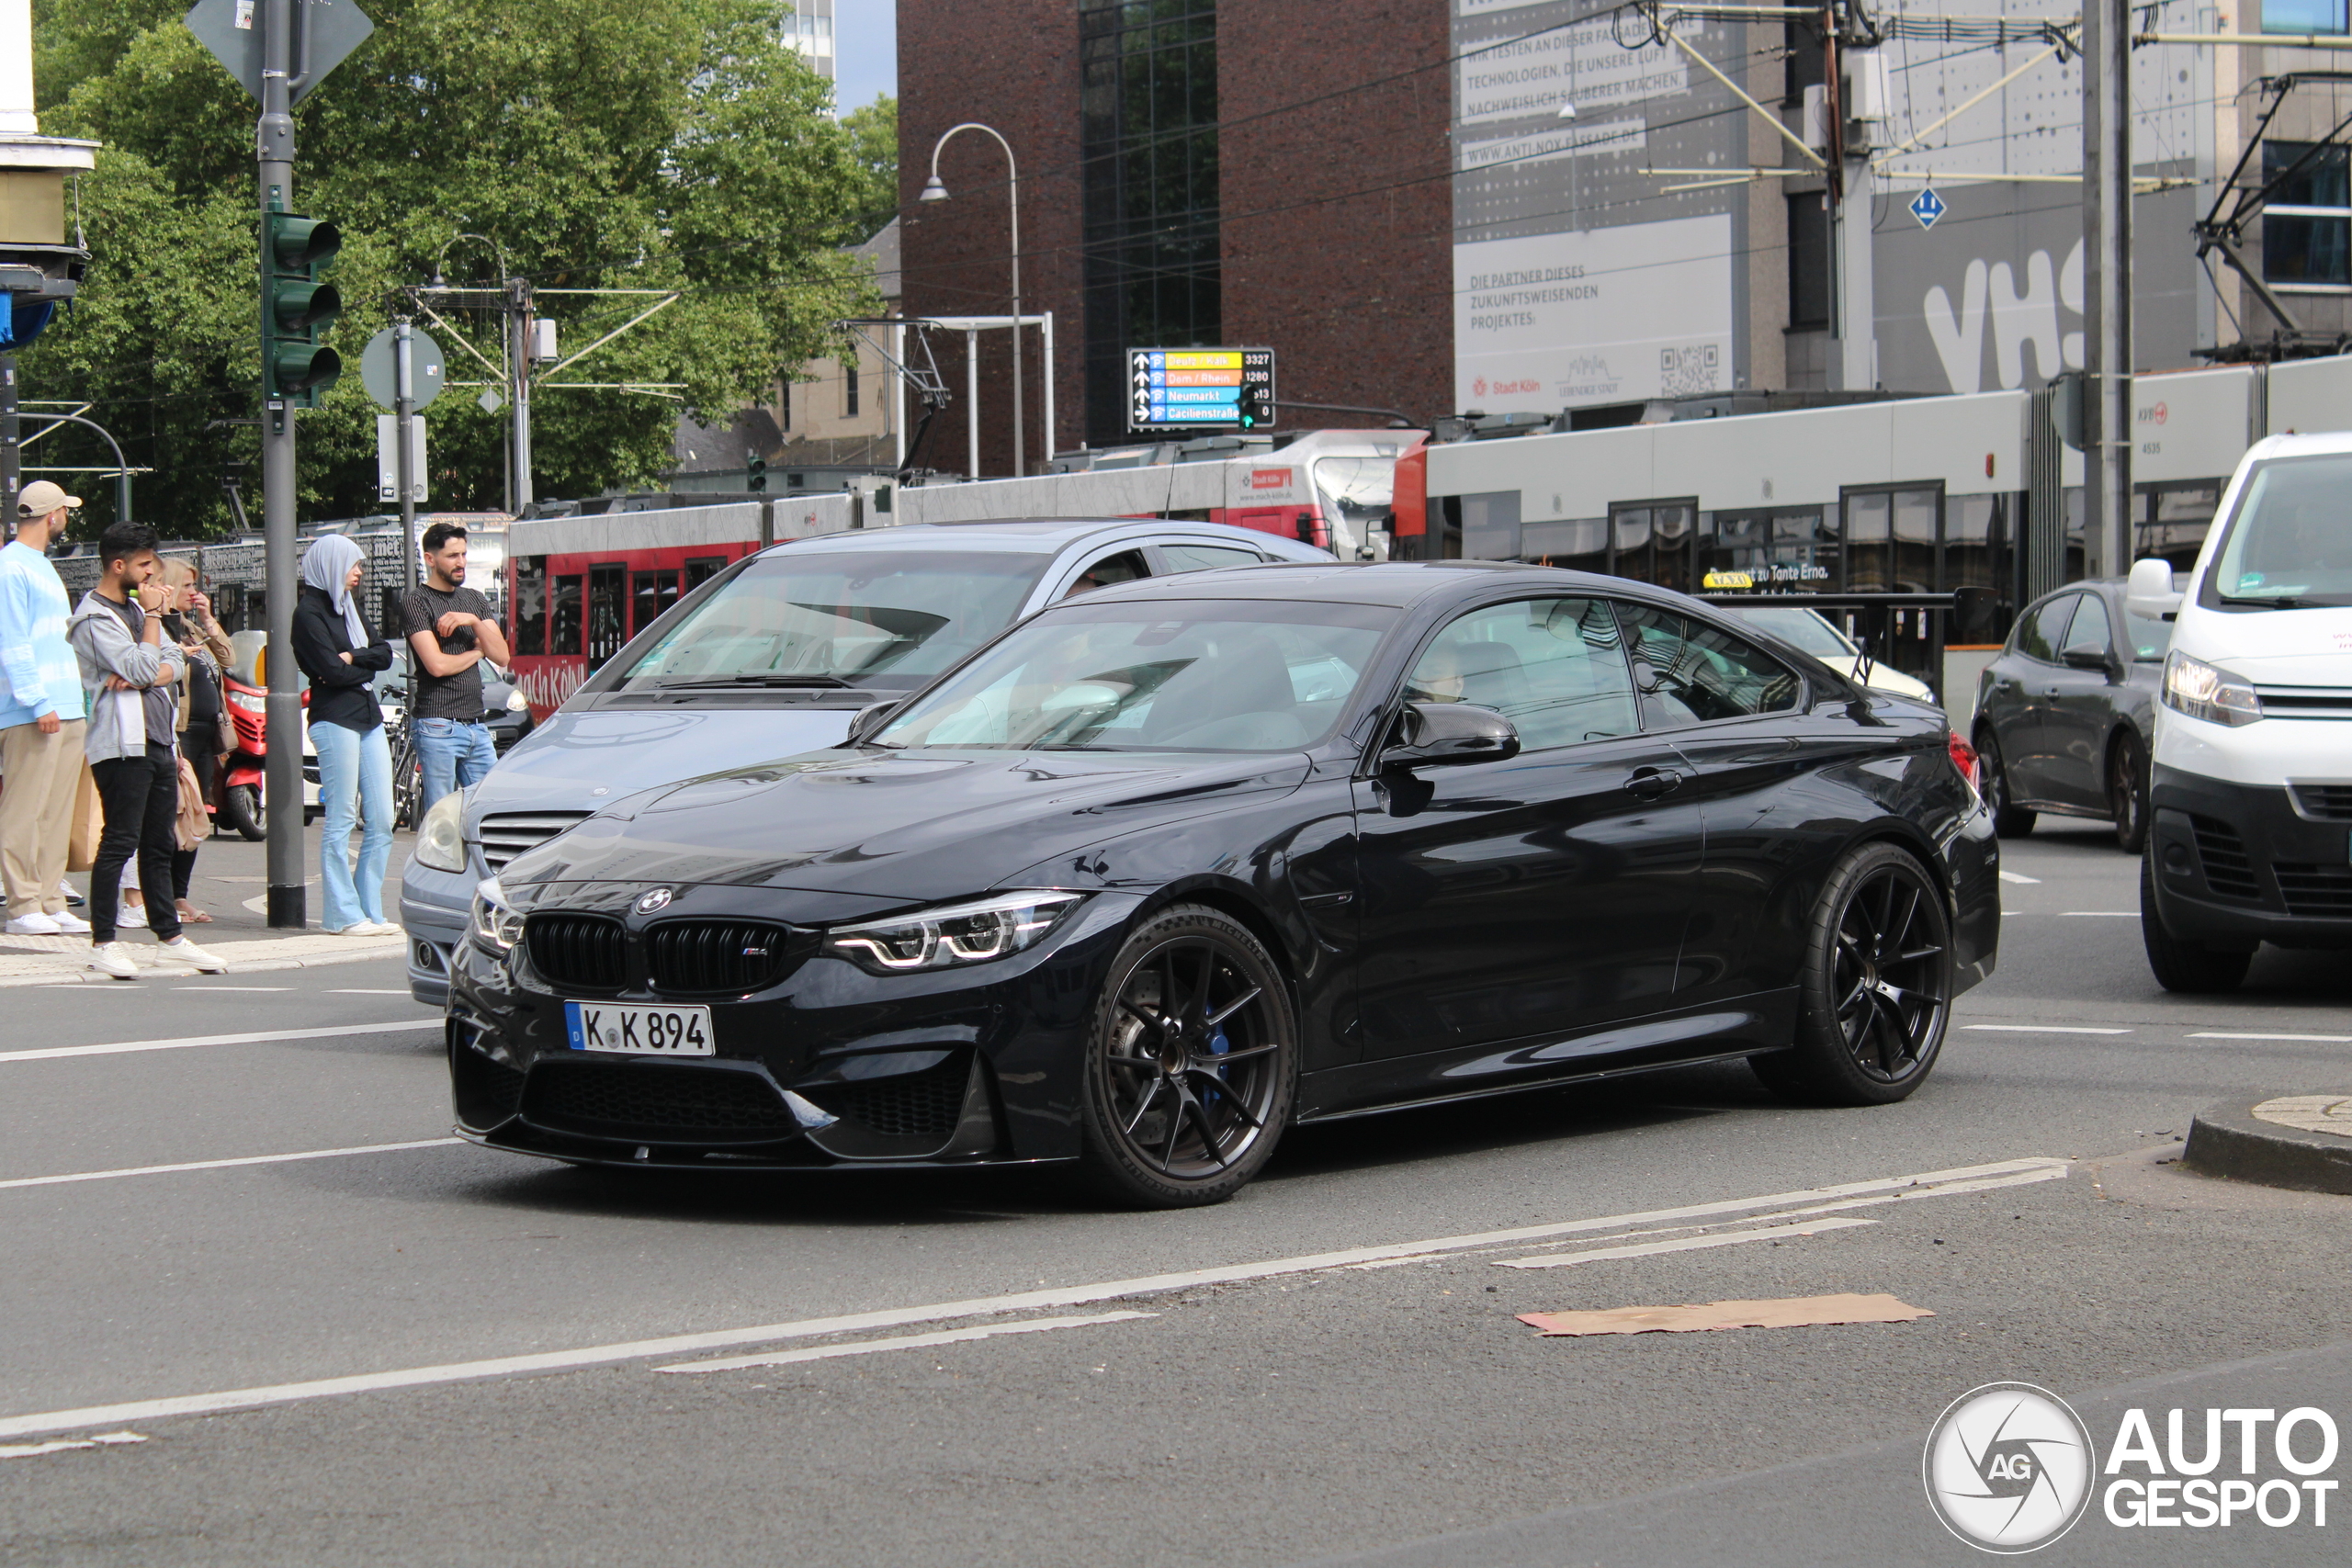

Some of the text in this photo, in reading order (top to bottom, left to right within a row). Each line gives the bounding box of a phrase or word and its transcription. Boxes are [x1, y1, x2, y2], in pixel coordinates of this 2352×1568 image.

[1466, 47, 1489, 63] WIR
[1492, 41, 1532, 62] TESTEN
[1535, 38, 1552, 51] AN
[1554, 33, 1594, 50] DIESER
[1596, 26, 1647, 44] FASSADE
[1468, 47, 1668, 90] TECHNOLOGIEN, DIE UNSERE LUFT
[1467, 73, 1682, 116] NACHWEISLICH SAUBERER MACHEN.
[1470, 265, 1585, 289] DIE PARTNER DIESES
[1470, 285, 1599, 310] ZUKUNFTSWEISENDEN
[1471, 311, 1536, 332] PROJEKTES:
[1245, 355, 1270, 366] 3327
[1169, 374, 1192, 384] Dom
[1202, 373, 1230, 383] Rhein
[1246, 371, 1269, 382] 1280
[1493, 378, 1541, 395] Stadt Köln
[1559, 383, 1619, 398] LEBENDIGE STADT
[1169, 390, 1220, 401] Neumarkt
[1168, 407, 1239, 419] Cäcilienstraße
[1262, 406, 1270, 416] 0
[2143, 443, 2161, 455] 4535
[1713, 575, 1746, 585] TAXI
[1758, 570, 1770, 581] zu
[1770, 564, 1799, 581] Tante
[1801, 563, 1828, 580] Erna.
[1212, 919, 1265, 961] MICHELIN
[748, 947, 768, 956] M4
[572, 1031, 581, 1042] D
[584, 1010, 705, 1049] K K 894
